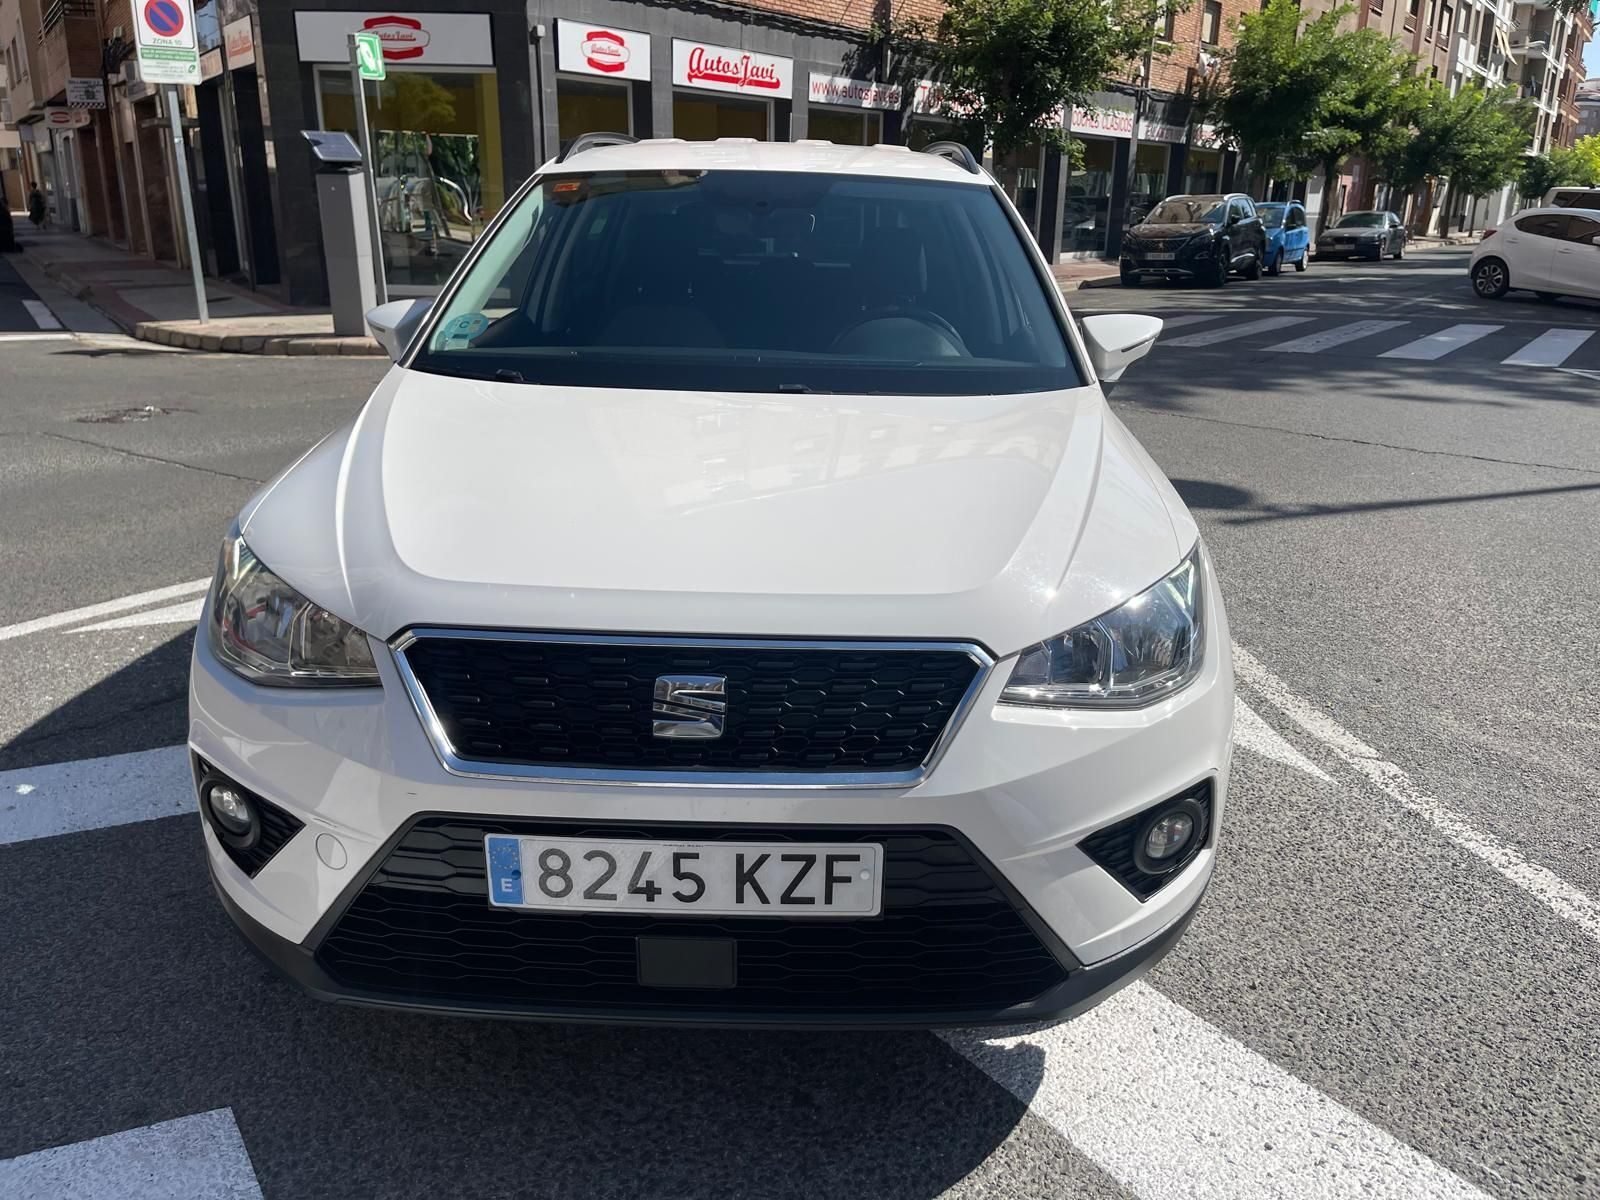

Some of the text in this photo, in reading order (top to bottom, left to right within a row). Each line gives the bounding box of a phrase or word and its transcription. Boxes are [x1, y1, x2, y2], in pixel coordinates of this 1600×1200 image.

[501, 878, 513, 892] E
[538, 848, 861, 905] 8245 KZF
